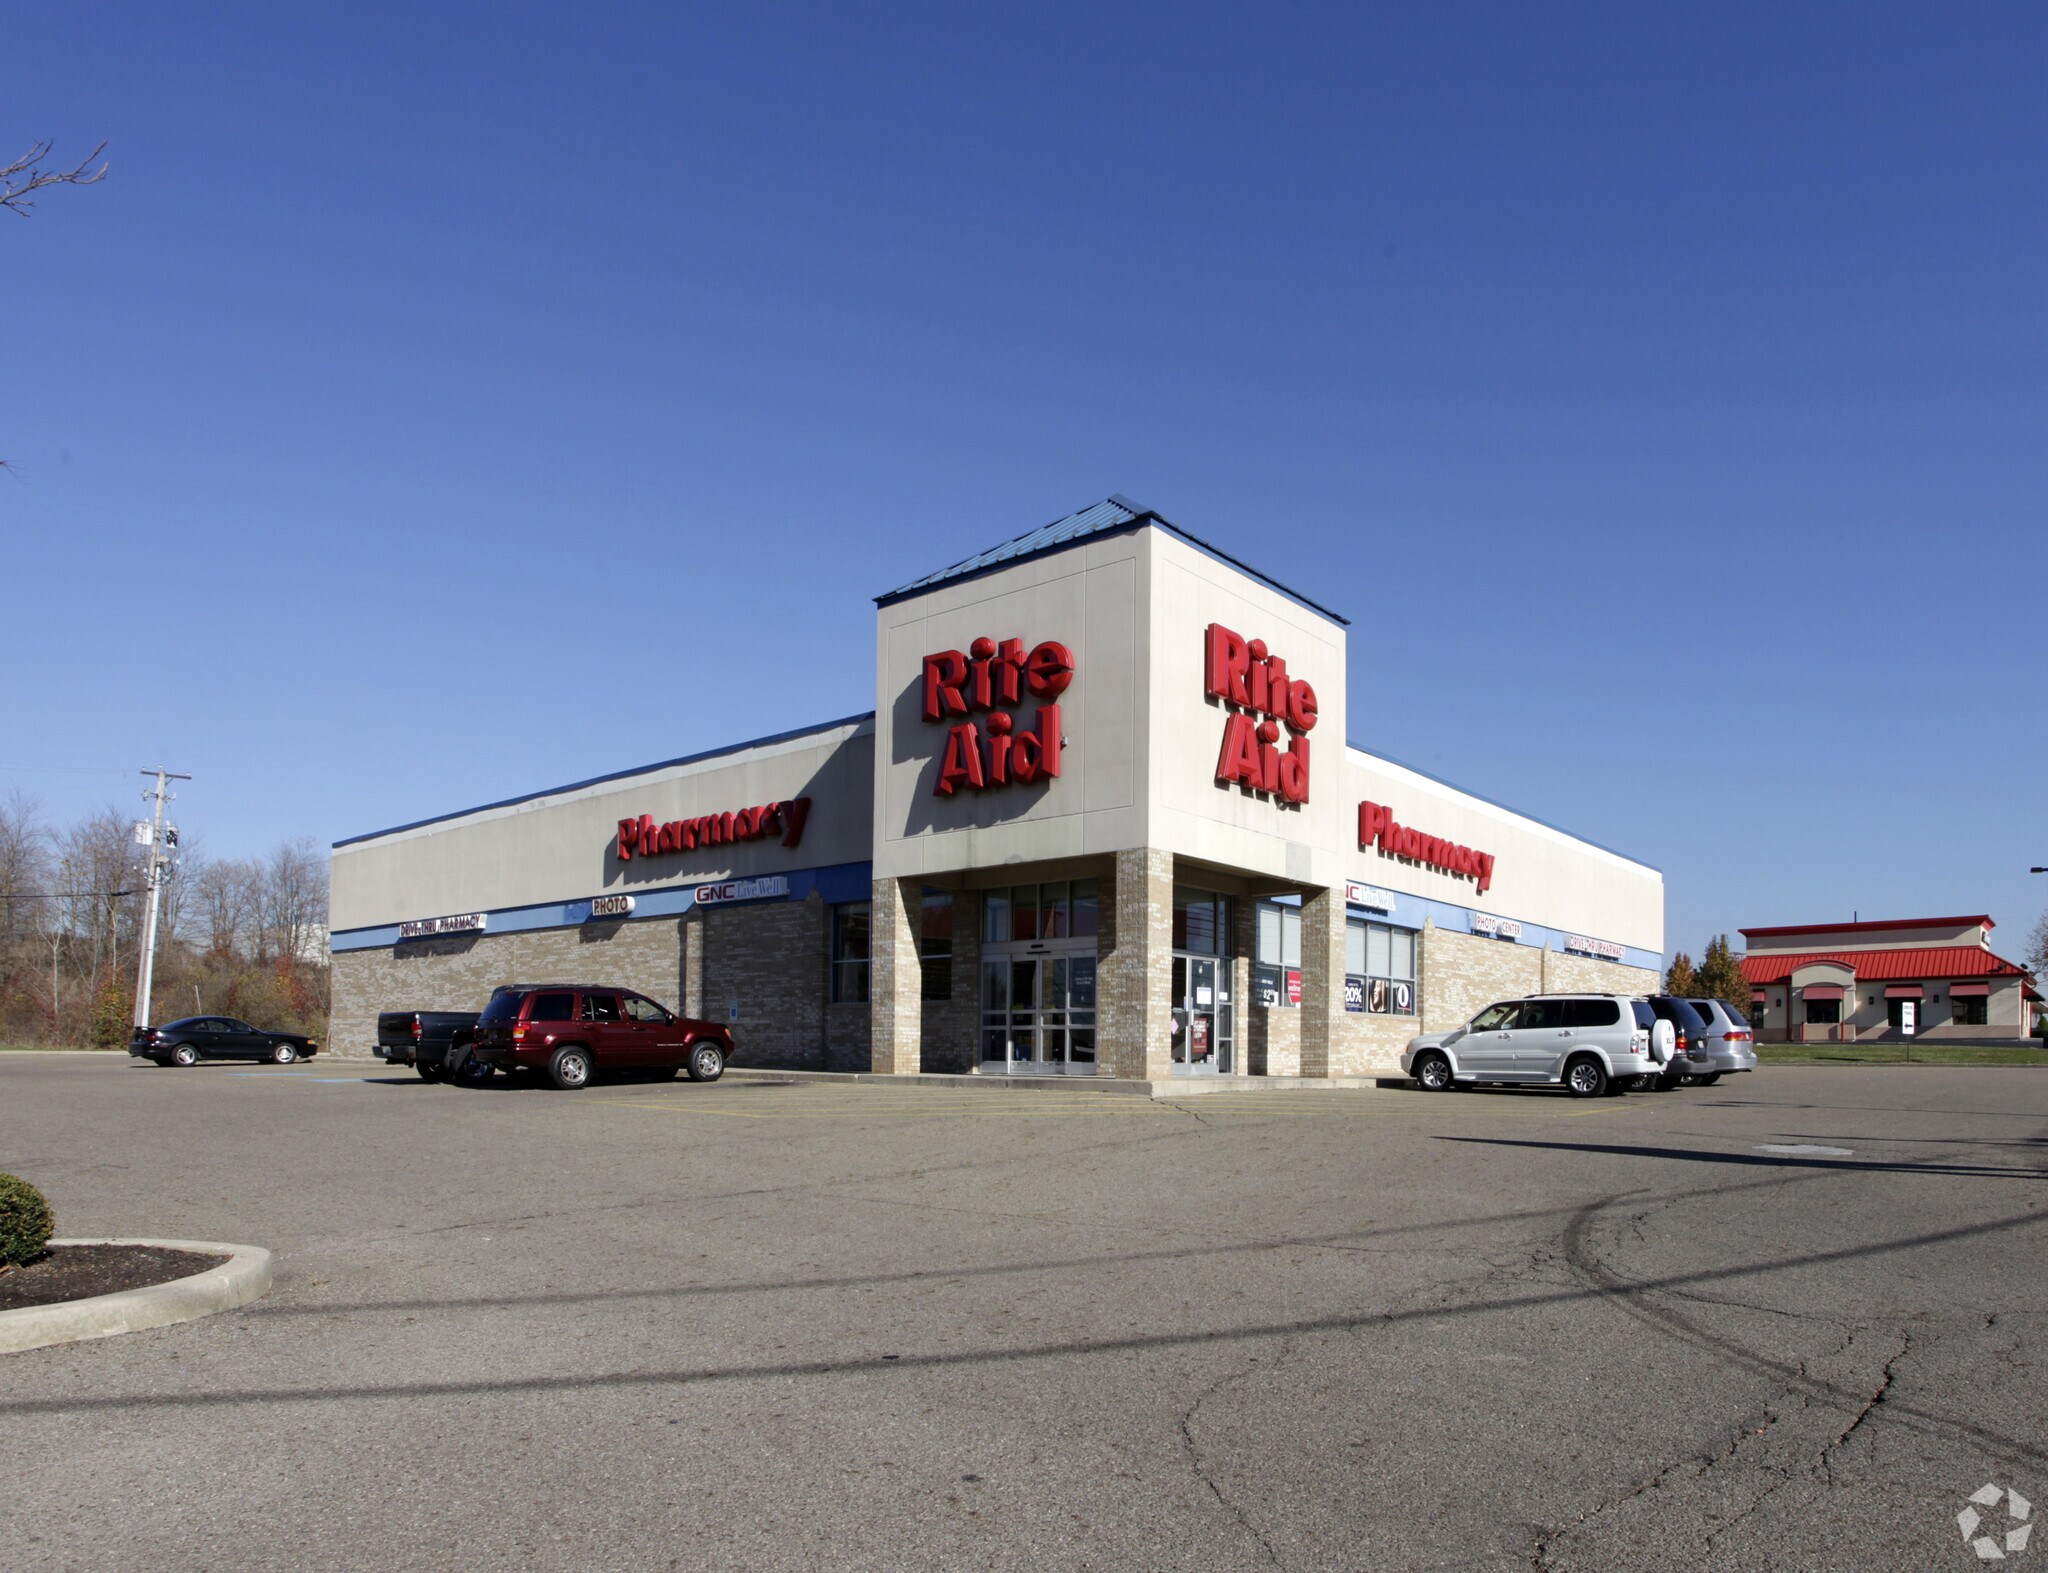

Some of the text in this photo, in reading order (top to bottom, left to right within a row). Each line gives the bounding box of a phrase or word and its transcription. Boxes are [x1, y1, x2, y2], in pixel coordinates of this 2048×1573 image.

[922, 637, 1075, 722] Rite
[1207, 623, 1318, 732] Rite
[933, 704, 1061, 797] Aid
[1217, 712, 1310, 805] Aid
[617, 797, 812, 861] Pharmacy
[1360, 800, 1495, 891] Pharmacy
[593, 897, 628, 914] PHOTO
[696, 884, 735, 902] GNC
[400, 915, 480, 937] DRIVE-THRU PHARMACY
[1477, 915, 1520, 936] PHOTO CENTER
[1345, 986, 1362, 1002] 20%
